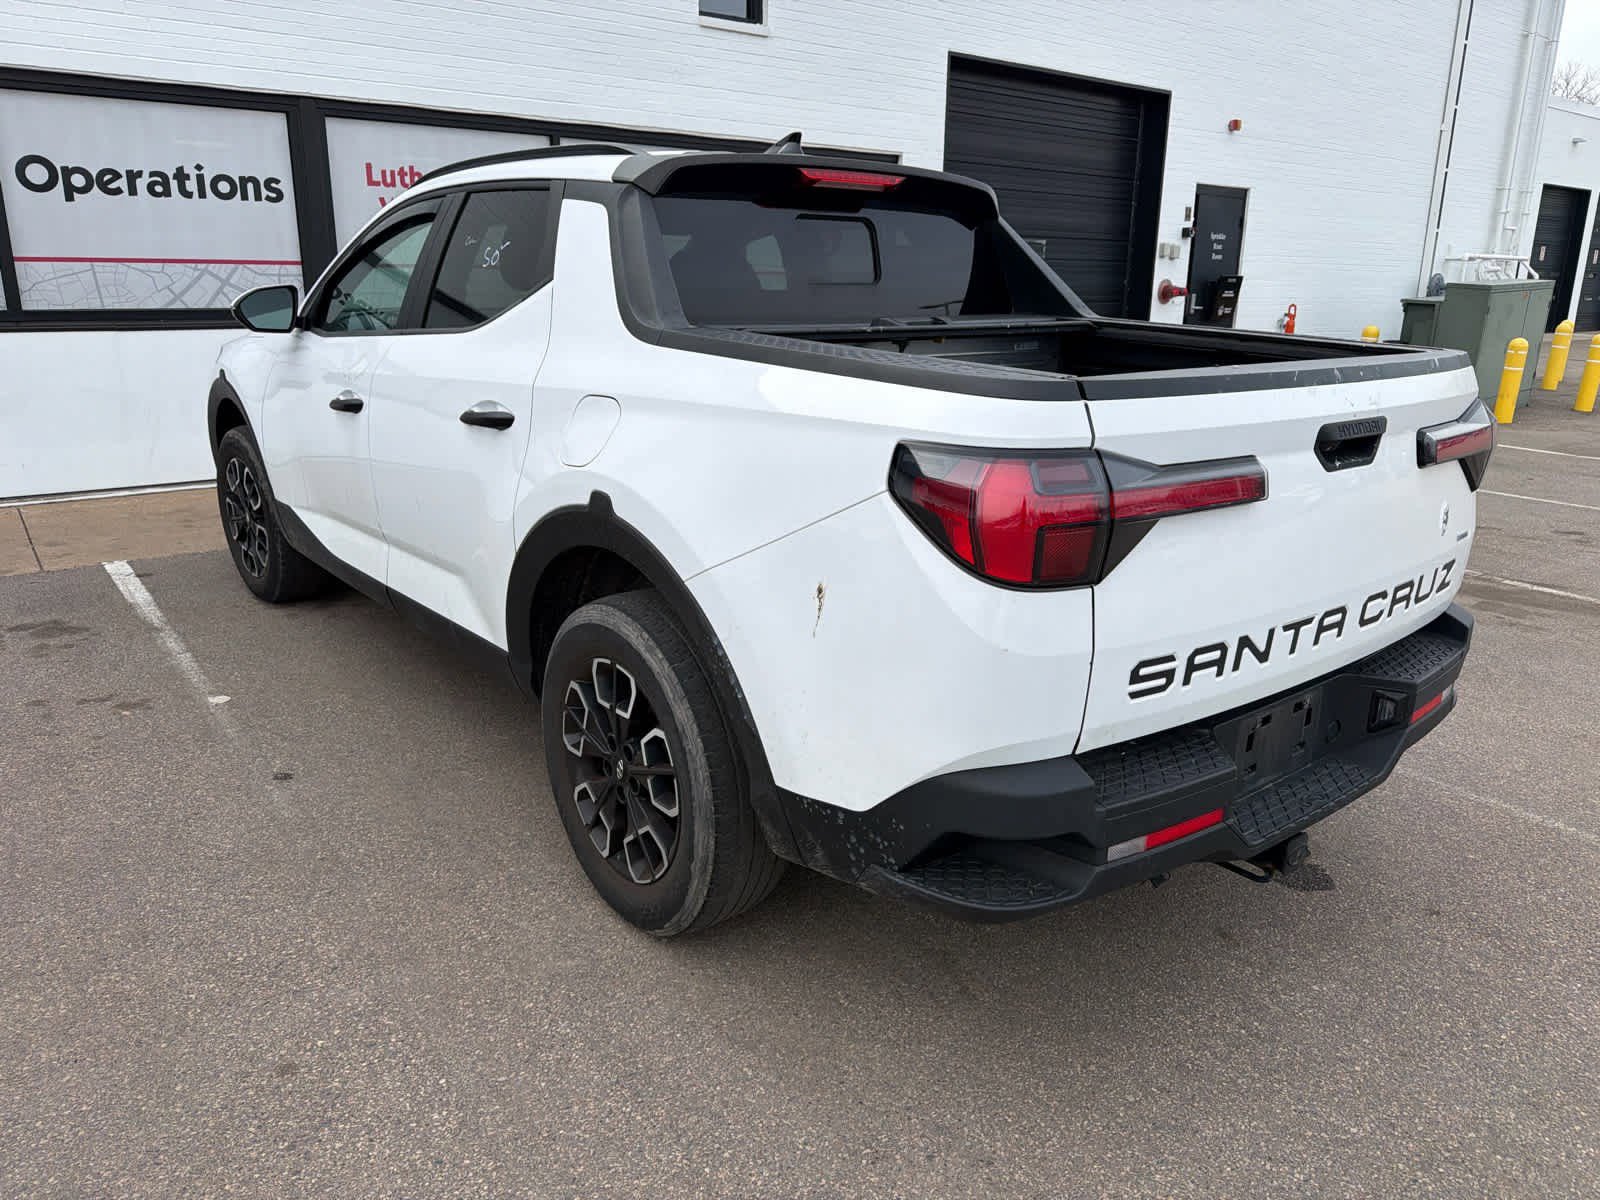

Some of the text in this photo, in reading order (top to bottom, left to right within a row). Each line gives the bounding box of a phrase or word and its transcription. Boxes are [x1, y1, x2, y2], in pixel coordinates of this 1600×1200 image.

[15, 154, 285, 203] Operations
[1337, 419, 1385, 438] HYUNDAI
[1128, 559, 1456, 699] SANTA CRUZ
